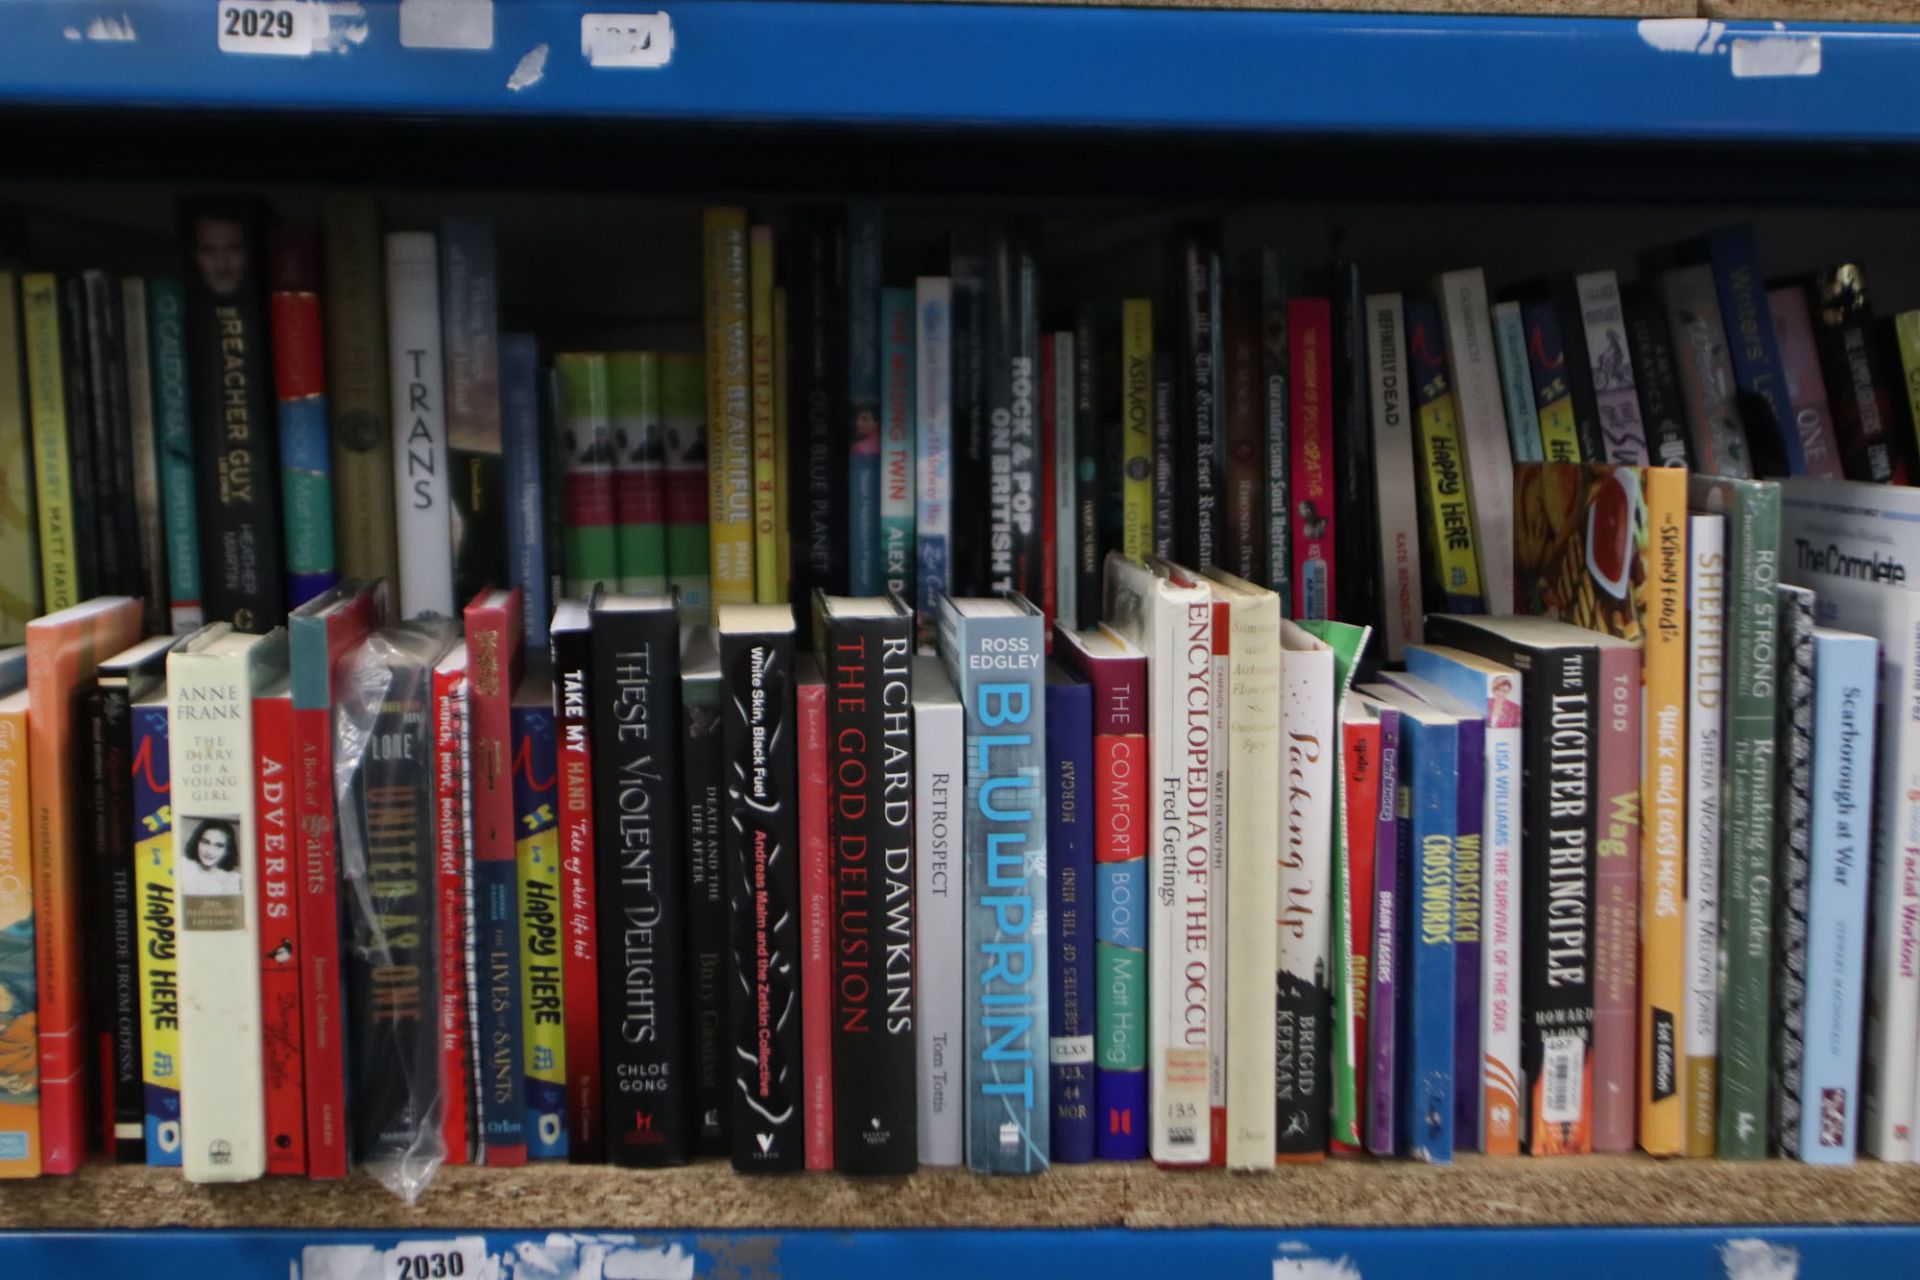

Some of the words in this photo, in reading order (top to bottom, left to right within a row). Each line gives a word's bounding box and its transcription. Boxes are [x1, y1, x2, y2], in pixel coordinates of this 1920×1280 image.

[224, 6, 293, 39] 2029
[1728, 265, 1768, 363] Writers'
[1378, 309, 1398, 374] DEFINITELY
[160, 322, 184, 437] CALEDONIA
[221, 319, 249, 439] REACHER
[889, 352, 909, 441] MISSING
[1012, 356, 1032, 437] ROCK
[1127, 356, 1146, 436] ASIMOV
[1382, 376, 1400, 426] DEAD
[407, 349, 434, 509] TRANS
[992, 408, 1010, 449] ON
[1197, 389, 1214, 437] Great
[1268, 375, 1284, 479] Curanderismo
[1797, 408, 1827, 464] ONE
[229, 449, 252, 502] GUY
[727, 385, 749, 524] BEAUTIFUL
[810, 444, 828, 491] BLUE
[889, 451, 907, 501] TWIN
[1012, 442, 1031, 466] &
[1431, 436, 1461, 494] HAPPY
[991, 454, 1010, 574] BRITISH
[1013, 472, 1032, 535] POP
[1442, 503, 1469, 550] HERE
[49, 508, 65, 557] MATT
[239, 523, 256, 594] HEATHER
[810, 500, 828, 572] PLANET
[887, 526, 903, 573] ALEX
[1659, 524, 1681, 583] SKINNY
[223, 531, 241, 588] MARTIN
[1754, 550, 1774, 597] ROY
[53, 563, 69, 610] HAIG
[981, 638, 1030, 652] ROSS
[1697, 552, 1722, 709] SHEFFIELD
[1752, 603, 1772, 698] STRONG
[750, 646, 764, 686] White
[836, 636, 865, 714] THE
[970, 655, 1040, 669] EDGLEY
[1562, 655, 1584, 689] THE
[177, 704, 242, 721] FRANK
[178, 685, 239, 701] ANNE
[563, 669, 583, 717] TAKE
[614, 642, 652, 742] THESE
[749, 689, 765, 724] Skin,
[1111, 683, 1130, 724] THE
[1613, 674, 1629, 732] TODD
[195, 736, 224, 747] THE
[437, 696, 455, 747] munch,
[565, 725, 585, 753] MY
[752, 726, 766, 765] Black
[882, 636, 908, 827] RICHARD
[1186, 602, 1210, 840] ENCYCLOPEDIA
[186, 749, 233, 761] DIARY
[303, 758, 317, 787] Book
[437, 752, 454, 792] move,
[839, 727, 867, 820] GOD
[1494, 743, 1510, 772] LISA
[1550, 693, 1589, 818] LUCIFER
[1700, 729, 1718, 791] SHEENA
[1734, 740, 1748, 761] The
[1833, 687, 1861, 815] Scarborough
[182, 776, 238, 788] YOUNG
[192, 791, 228, 801] GIRL
[568, 762, 586, 811] HAND
[753, 767, 767, 797] Fuel
[1061, 761, 1076, 824] MORGAN
[1110, 742, 1131, 856] COMFORT
[1162, 777, 1181, 821] Fred
[1214, 770, 1224, 801] WAKE
[1277, 730, 1320, 870] Packing
[1748, 738, 1775, 849] Remaking
[439, 798, 457, 875] moisturise!
[620, 755, 663, 891] VIOLENT
[691, 805, 702, 833] LIFE
[706, 786, 717, 834] DEATH
[931, 773, 951, 897] RETROSPECT
[1214, 803, 1224, 844] ISLAND
[1494, 775, 1509, 846] WILLIAMS
[1598, 791, 1639, 857] Wag
[1838, 821, 1855, 839] at
[262, 755, 288, 919] ADVERBS
[301, 815, 330, 894] Saints
[367, 785, 420, 898] UNITED
[692, 839, 704, 883] AFTER
[707, 839, 718, 868] AND
[754, 830, 767, 887] Andreas
[1213, 847, 1224, 869] 1941
[1493, 851, 1508, 875] THE
[1699, 796, 1717, 891] WOODHEAD
[1731, 820, 1747, 899] Transformed
[113, 868, 127, 909] THE
[563, 856, 582, 874] my
[708, 875, 719, 901] THE
[1063, 866, 1076, 903] MIND
[1157, 826, 1181, 907] Gettings
[1186, 845, 1209, 883] OF
[1421, 834, 1452, 945] CROSSWORDS
[1454, 834, 1482, 943] WORDSEARCH
[1834, 846, 1854, 886] War
[524, 880, 558, 956] HAPPY
[573, 878, 588, 909] whole
[756, 891, 769, 928] Malm
[977, 682, 1034, 1109] BLUEPRINT
[1111, 871, 1131, 940] BOOK
[1185, 887, 1208, 953] THE
[1278, 880, 1315, 939] Up
[1378, 891, 1391, 930] BRAIN
[1493, 879, 1508, 945] SURVIVAL
[1548, 828, 1588, 988] PRINCIPLE
[1748, 876, 1771, 957] Garden
[115, 909, 130, 960] BRIDE
[144, 882, 177, 960] HAPPY
[569, 914, 591, 936] life
[757, 931, 770, 956] and
[811, 893, 823, 961] NOTEBOOK
[839, 834, 870, 1034] DELUSION
[885, 847, 912, 1035] DAWKINS
[1062, 910, 1075, 937] THE
[1899, 903, 1918, 979] Workout
[622, 906, 662, 1044] DELIGHTS
[758, 959, 771, 980] the
[1377, 932, 1391, 983] TEASERS
[1493, 949, 1507, 965] OF
[1698, 920, 1713, 985] MELVYN
[117, 964, 132, 1012] FROM
[149, 969, 179, 1031] HERE
[370, 965, 420, 1022] ONE
[490, 951, 510, 1012] LIVES
[529, 965, 561, 1025] HERE
[758, 983, 771, 1025] Zetkin
[1112, 957, 1132, 1007] Matt
[1184, 961, 1208, 1046] OCCU
[1493, 970, 1508, 996] THE
[1106, 1012, 1133, 1065] Haig
[1492, 1000, 1507, 1035] SOUL
[1535, 1007, 1594, 1026] HOWARD
[1658, 1021, 1672, 1038] 1st
[1694, 988, 1713, 1037] JONES
[119, 1017, 133, 1082] ODESSA
[490, 1031, 513, 1104] SAINTS
[616, 1063, 670, 1075] CHLOE
[759, 1028, 772, 1097] Collective
[932, 1033, 947, 1068] Tom
[1276, 1010, 1295, 1101] KEENAN
[1298, 1016, 1316, 1096] BRIGID
[1656, 1040, 1671, 1094] Edition
[619, 1078, 668, 1092] GONG
[932, 1071, 948, 1114] Tottis
[1058, 1104, 1087, 1120] MOR
[397, 1251, 465, 1280] 2030
